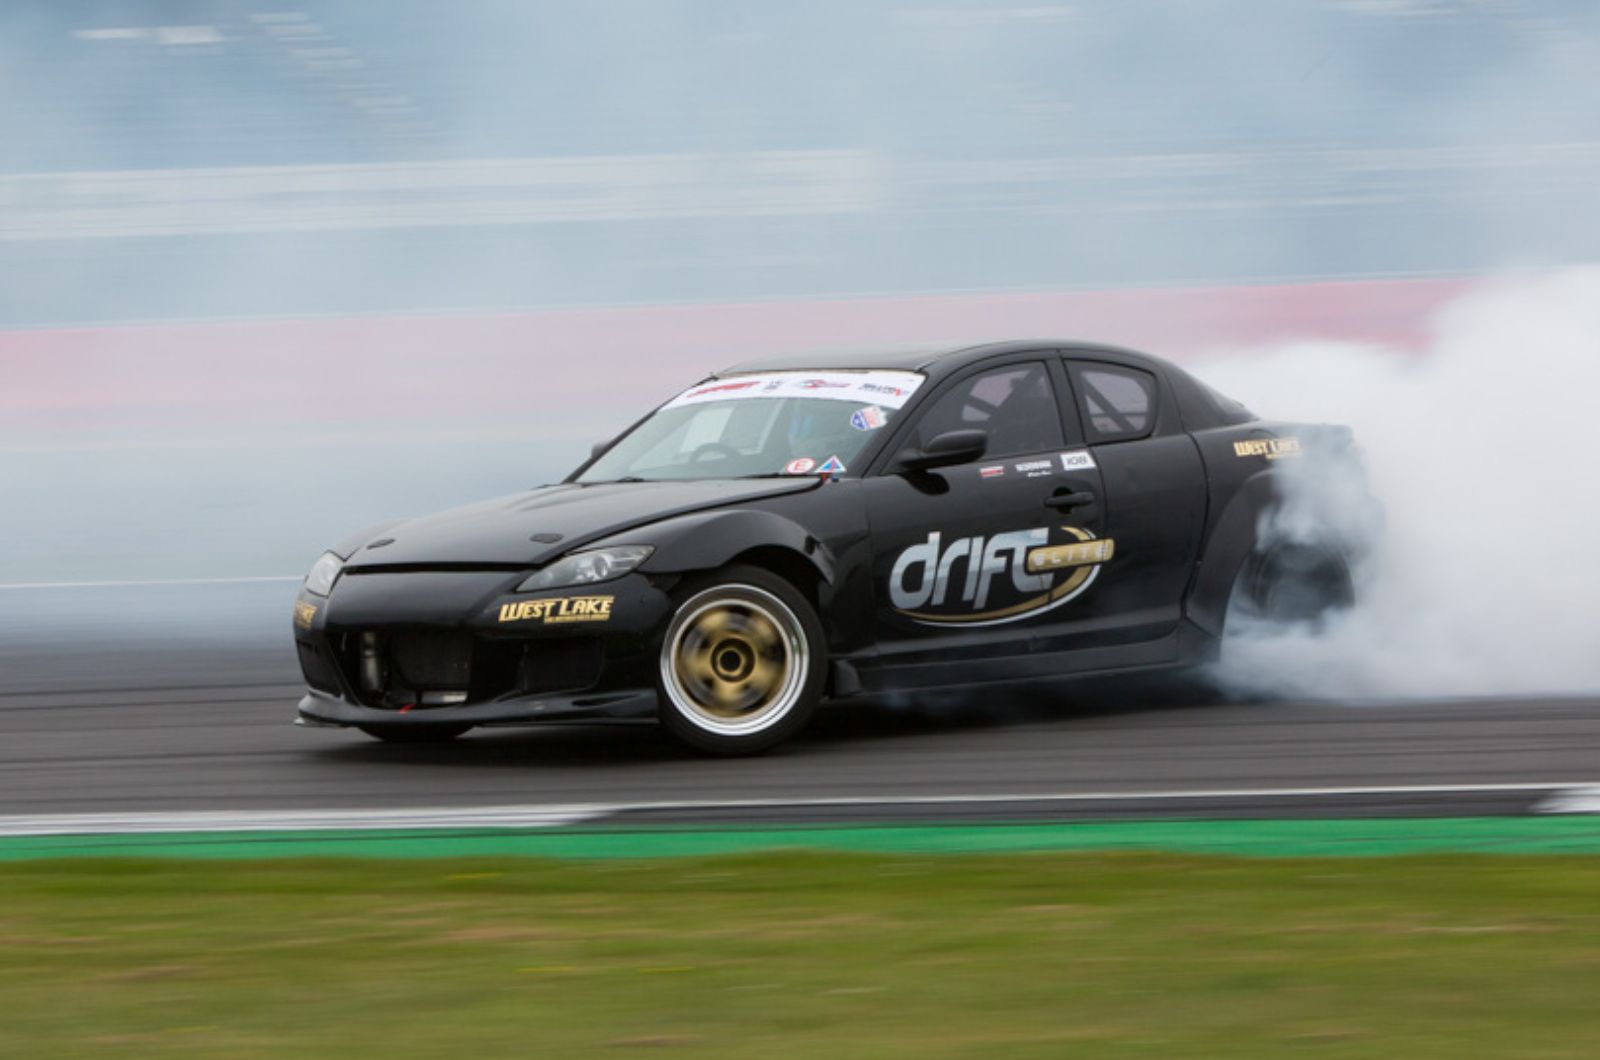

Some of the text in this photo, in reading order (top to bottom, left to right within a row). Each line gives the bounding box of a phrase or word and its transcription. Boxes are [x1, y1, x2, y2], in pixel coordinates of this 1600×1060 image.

[1234, 439, 1268, 457] WEST
[889, 527, 1054, 610] drift
[498, 599, 559, 622] WEST
[559, 595, 615, 615] LAKE
